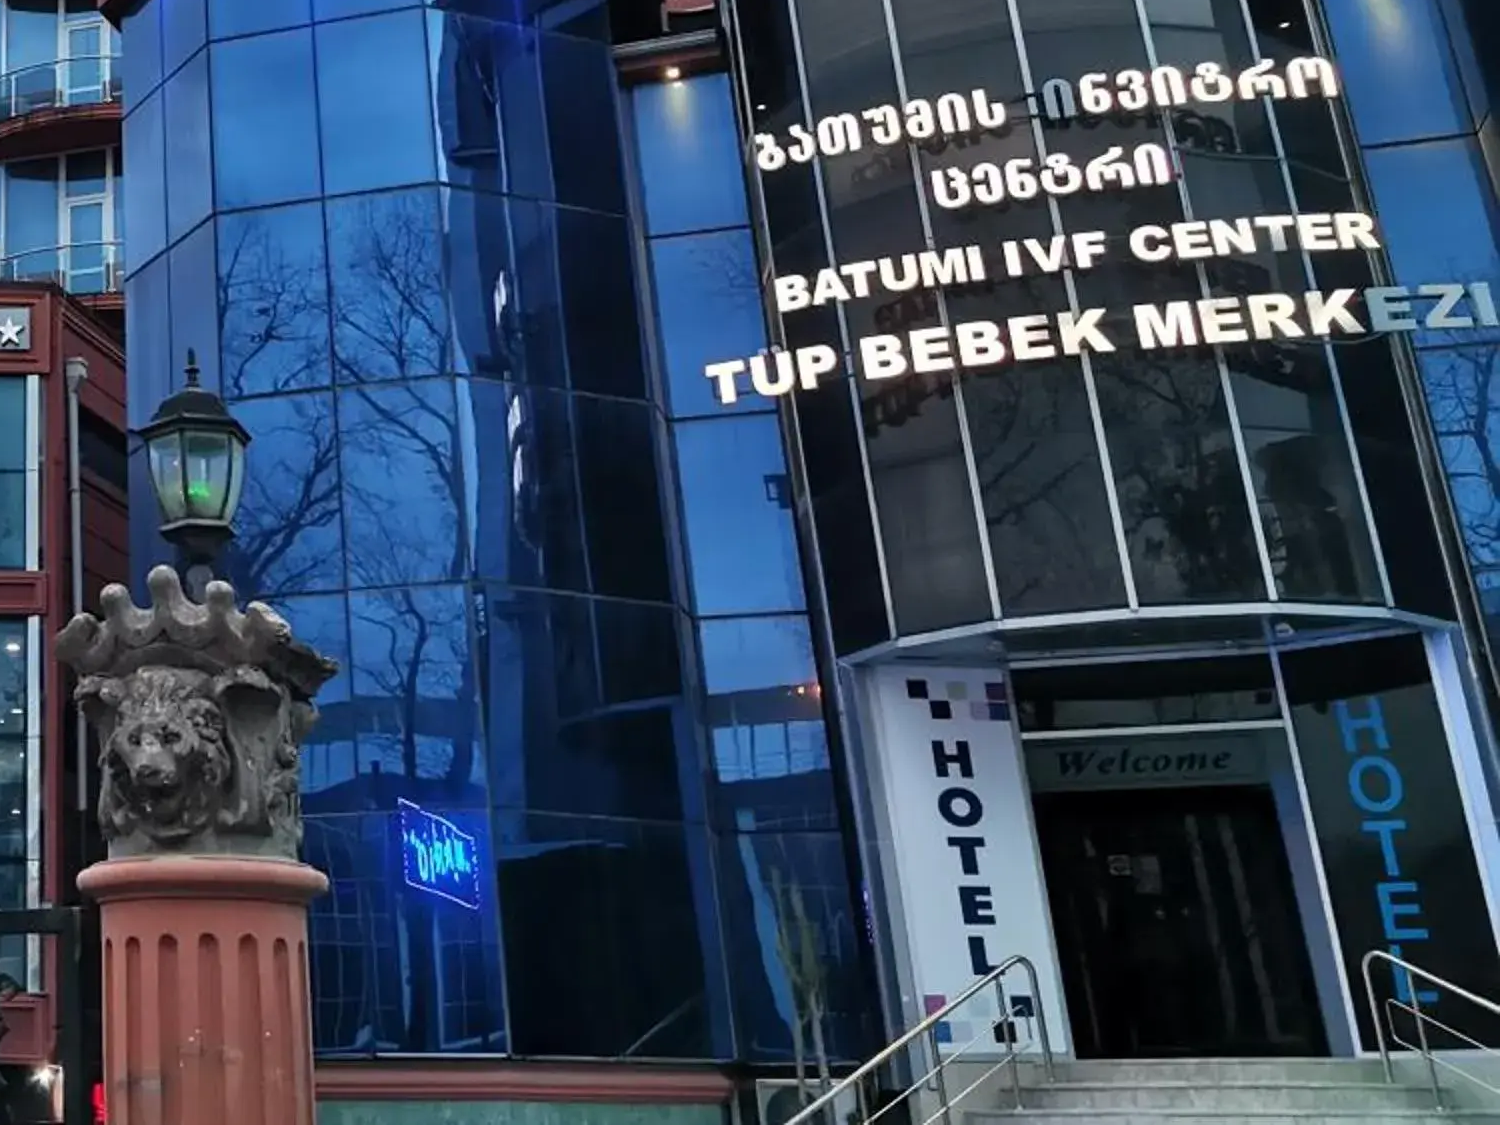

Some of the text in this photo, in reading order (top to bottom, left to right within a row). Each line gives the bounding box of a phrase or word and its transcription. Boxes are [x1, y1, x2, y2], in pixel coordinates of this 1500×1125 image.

[754, 55, 1339, 171] ბათუმის ინვიტრო
[930, 142, 1174, 210] ცენტრი
[774, 211, 1382, 313] BATUMI IVF CENTER
[705, 281, 1499, 405] TÜP BEBEK MERKEZI
[1055, 746, 1233, 778] Welcome
[930, 738, 1008, 978] HOTEL
[1331, 695, 1439, 1004] HOTEL
